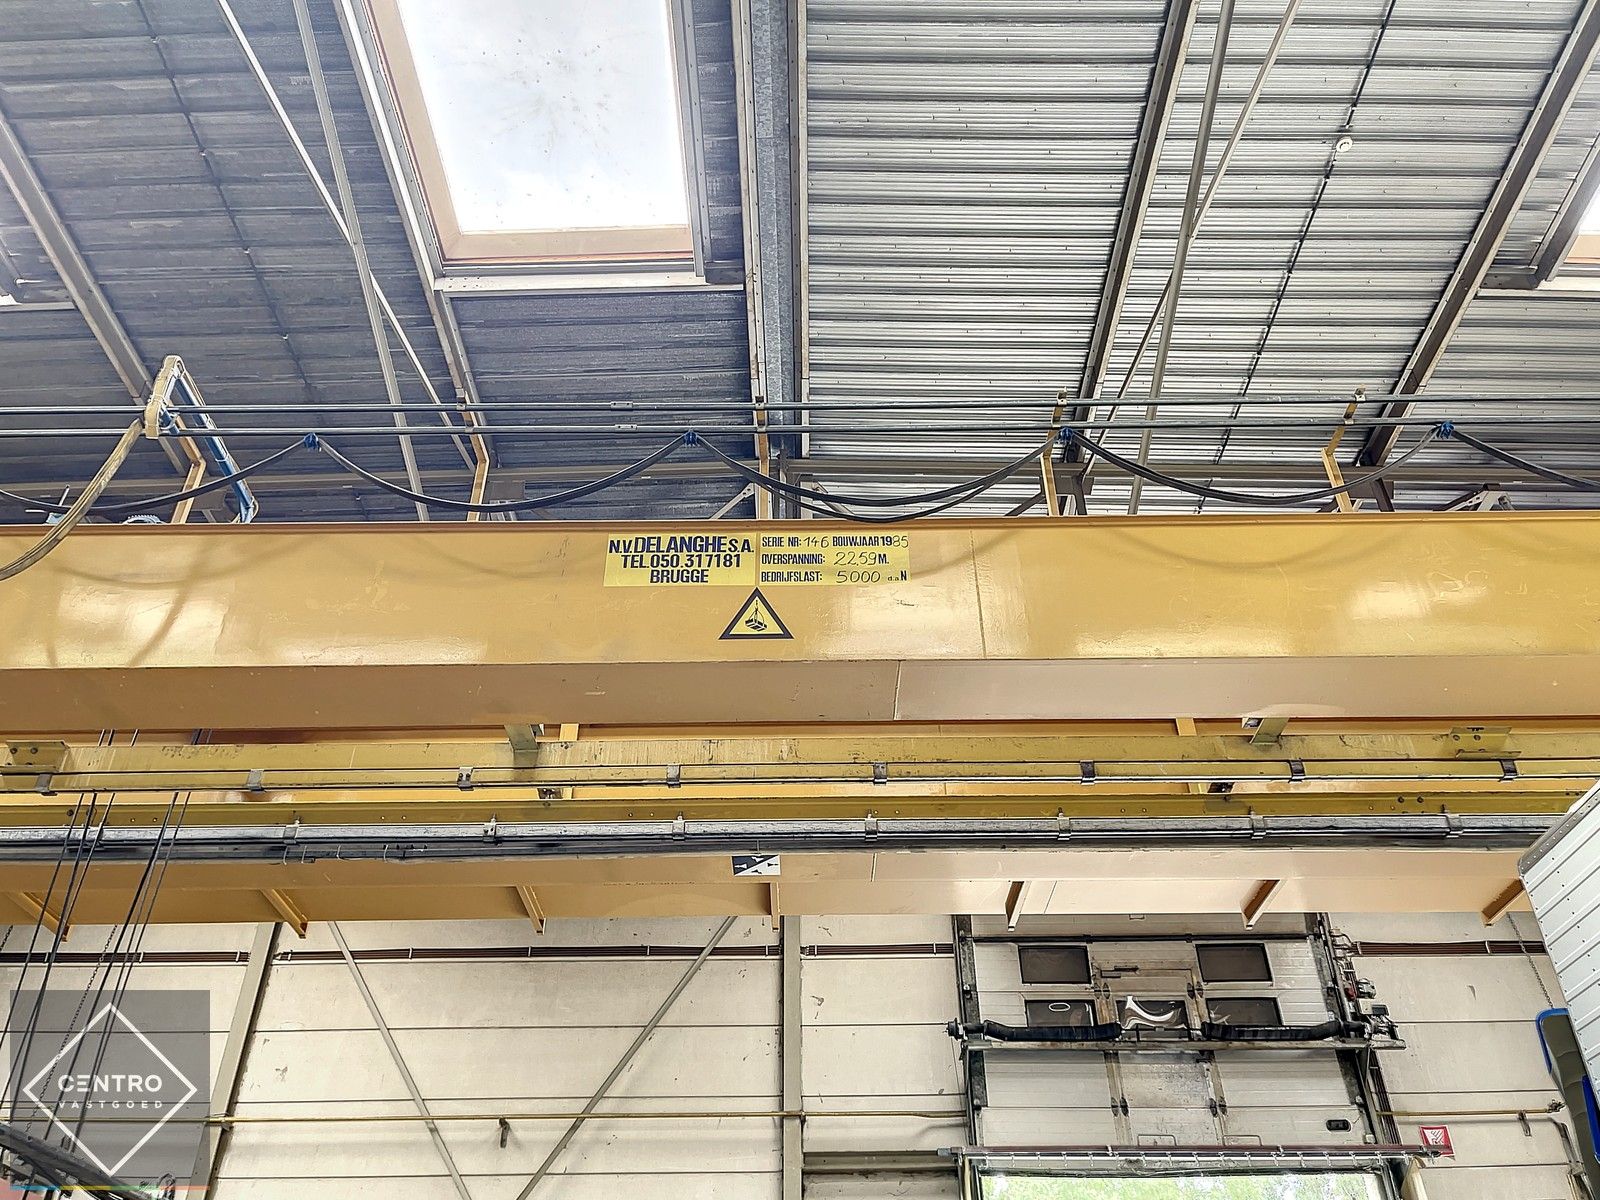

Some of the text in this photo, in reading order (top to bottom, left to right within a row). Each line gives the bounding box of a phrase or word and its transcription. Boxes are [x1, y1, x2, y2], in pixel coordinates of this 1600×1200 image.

[634, 536, 727, 553] DELANGHE
[762, 535, 909, 548] SERIE NR: 146 BOUWJAAR 1985
[761, 553, 826, 565] OVERSPANNING:
[650, 569, 709, 583] BRUGGE
[761, 571, 823, 582] BEDRIJFSLAST:
[836, 570, 881, 583] 5000
